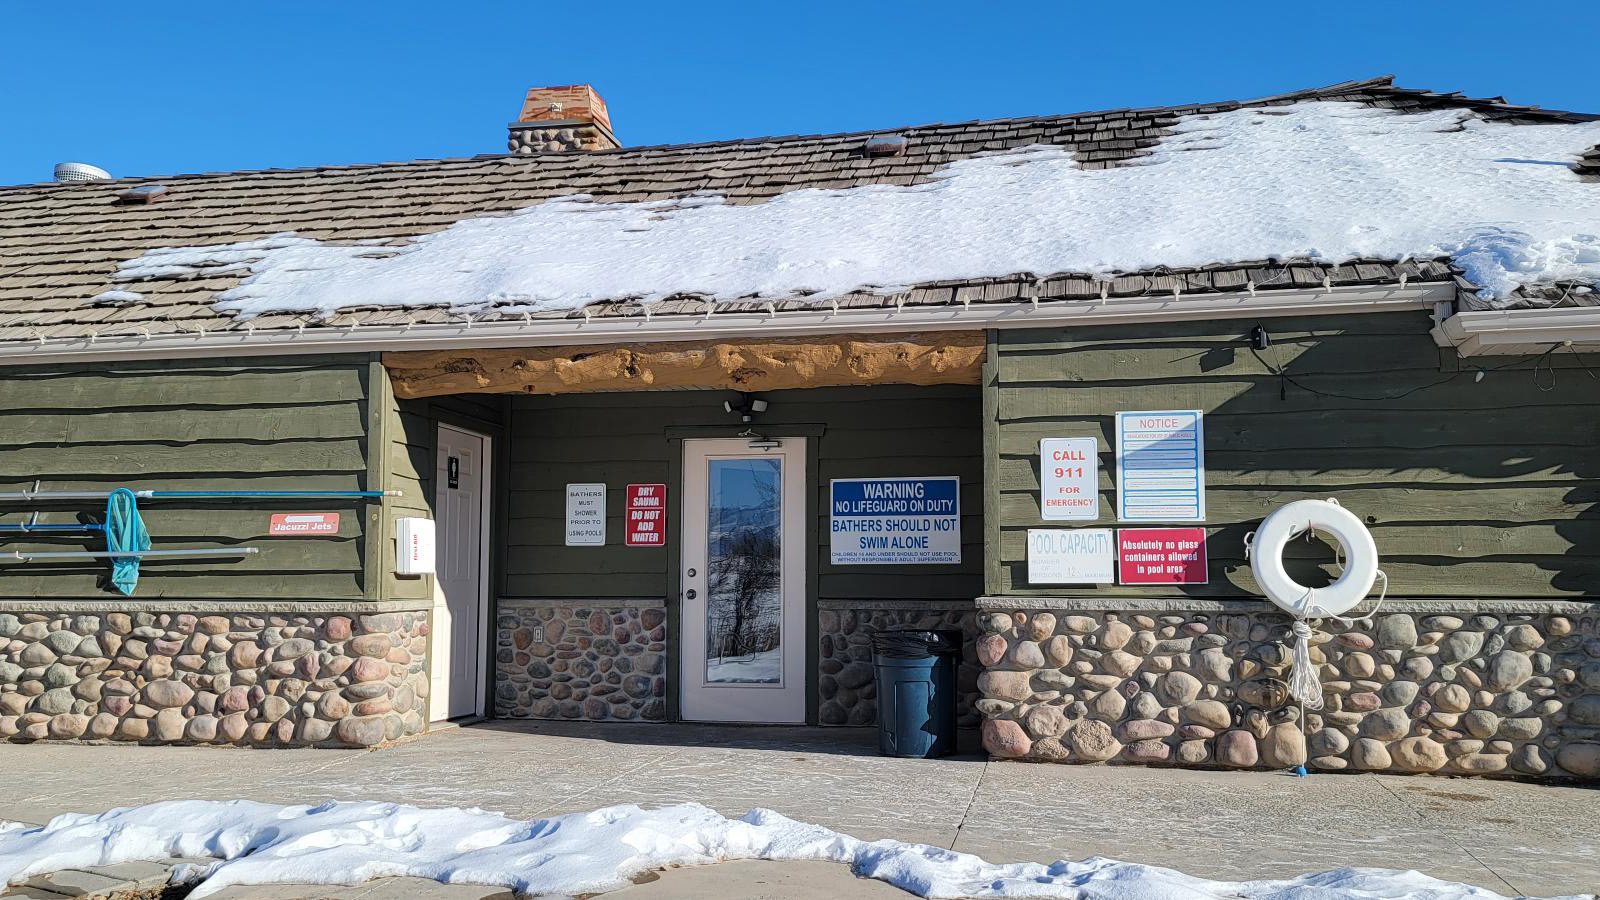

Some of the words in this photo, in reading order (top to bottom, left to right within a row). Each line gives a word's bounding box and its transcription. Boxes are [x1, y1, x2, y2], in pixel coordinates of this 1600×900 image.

[1140, 418, 1179, 429] NOTICE
[1053, 450, 1086, 461] CALL
[1054, 467, 1083, 478] 911
[637, 487, 654, 496] DRY
[863, 482, 924, 499] WARNING
[632, 497, 659, 507] SAUNA
[835, 500, 850, 513] NO
[852, 500, 908, 512] LIFEGUARD
[910, 500, 924, 512] ON
[927, 499, 953, 512] DUTY
[1046, 498, 1094, 507] EMERGENCY
[631, 510, 643, 520] DO
[644, 510, 660, 520] NOT
[637, 521, 654, 531] ADD
[832, 519, 882, 532] BATHERS
[885, 519, 931, 532] SHOULD
[934, 518, 956, 531] NOT
[631, 532, 659, 543] WATER
[859, 536, 889, 549] SWIM
[891, 536, 929, 549] ALONE
[1060, 532, 1109, 554] CAPACITY
[1122, 540, 1162, 550] Absolutely
[1178, 540, 1198, 550] glass
[1124, 552, 1165, 562] containers
[1168, 552, 1198, 560] allowed
[1137, 564, 1144, 574] in
[1148, 564, 1164, 575] pool
